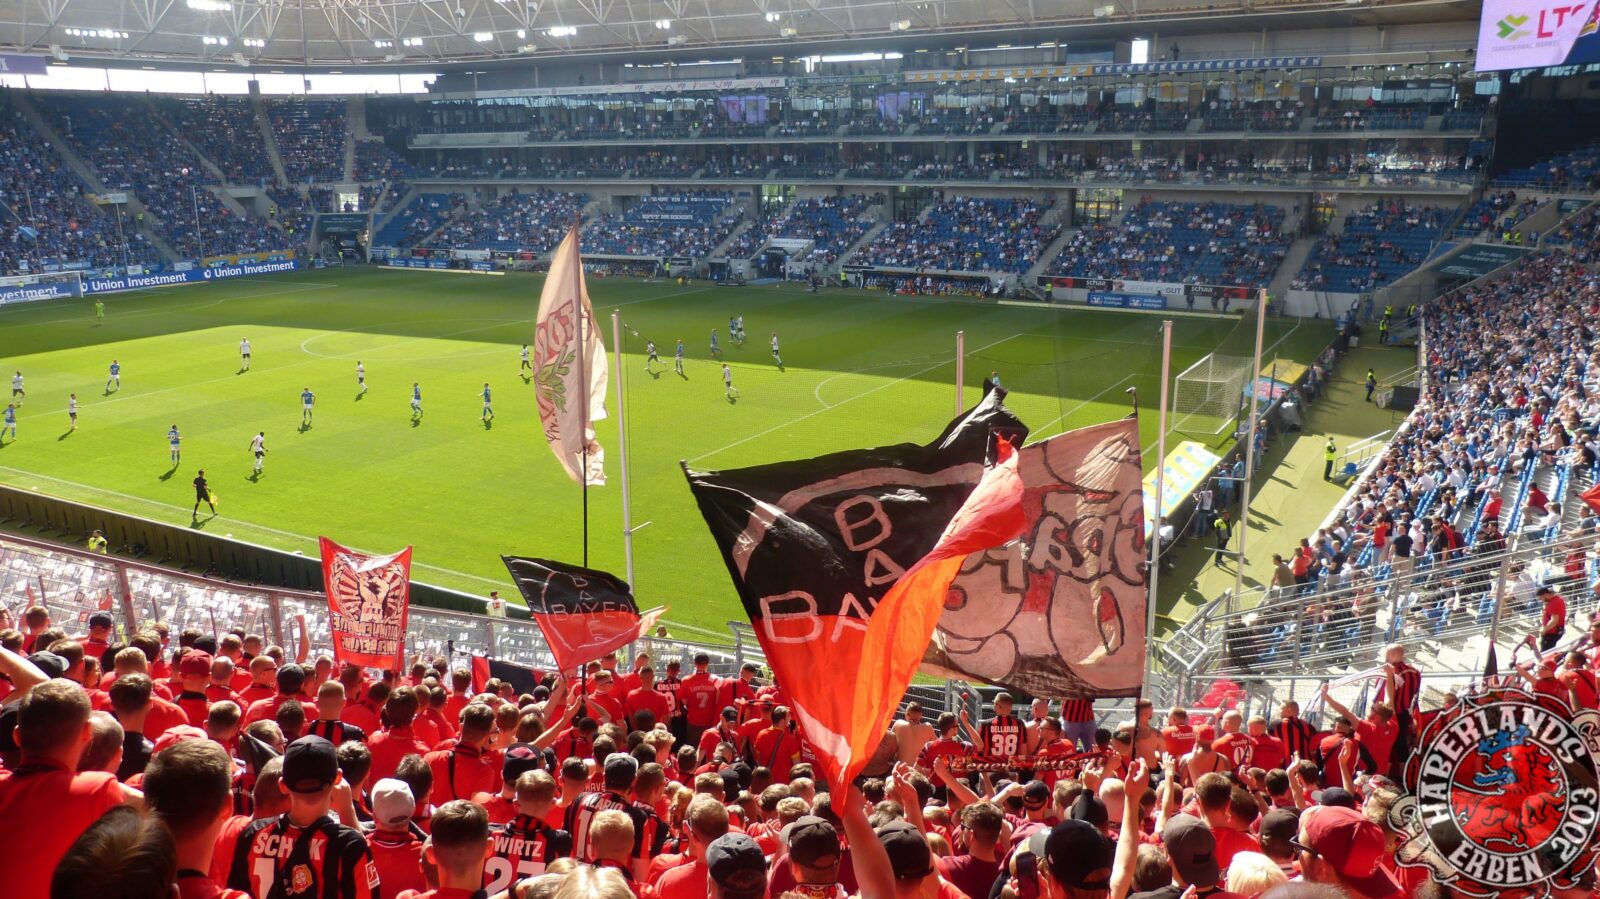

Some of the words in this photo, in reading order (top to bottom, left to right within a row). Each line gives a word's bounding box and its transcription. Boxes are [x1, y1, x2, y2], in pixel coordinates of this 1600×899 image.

[1537, 4, 1585, 38] LT
[214, 265, 242, 278] Union
[244, 261, 295, 275] Investment
[92, 279, 125, 292] Union
[128, 272, 187, 287] Investment
[1166, 287, 1182, 295] GUT
[0, 285, 58, 302] vestment
[696, 692, 710, 709] 7
[990, 734, 1019, 757] 38
[585, 781, 606, 792] HAVE
[253, 832, 326, 861] SCHK
[494, 835, 543, 858] WIRTZ
[253, 857, 275, 899] 1
